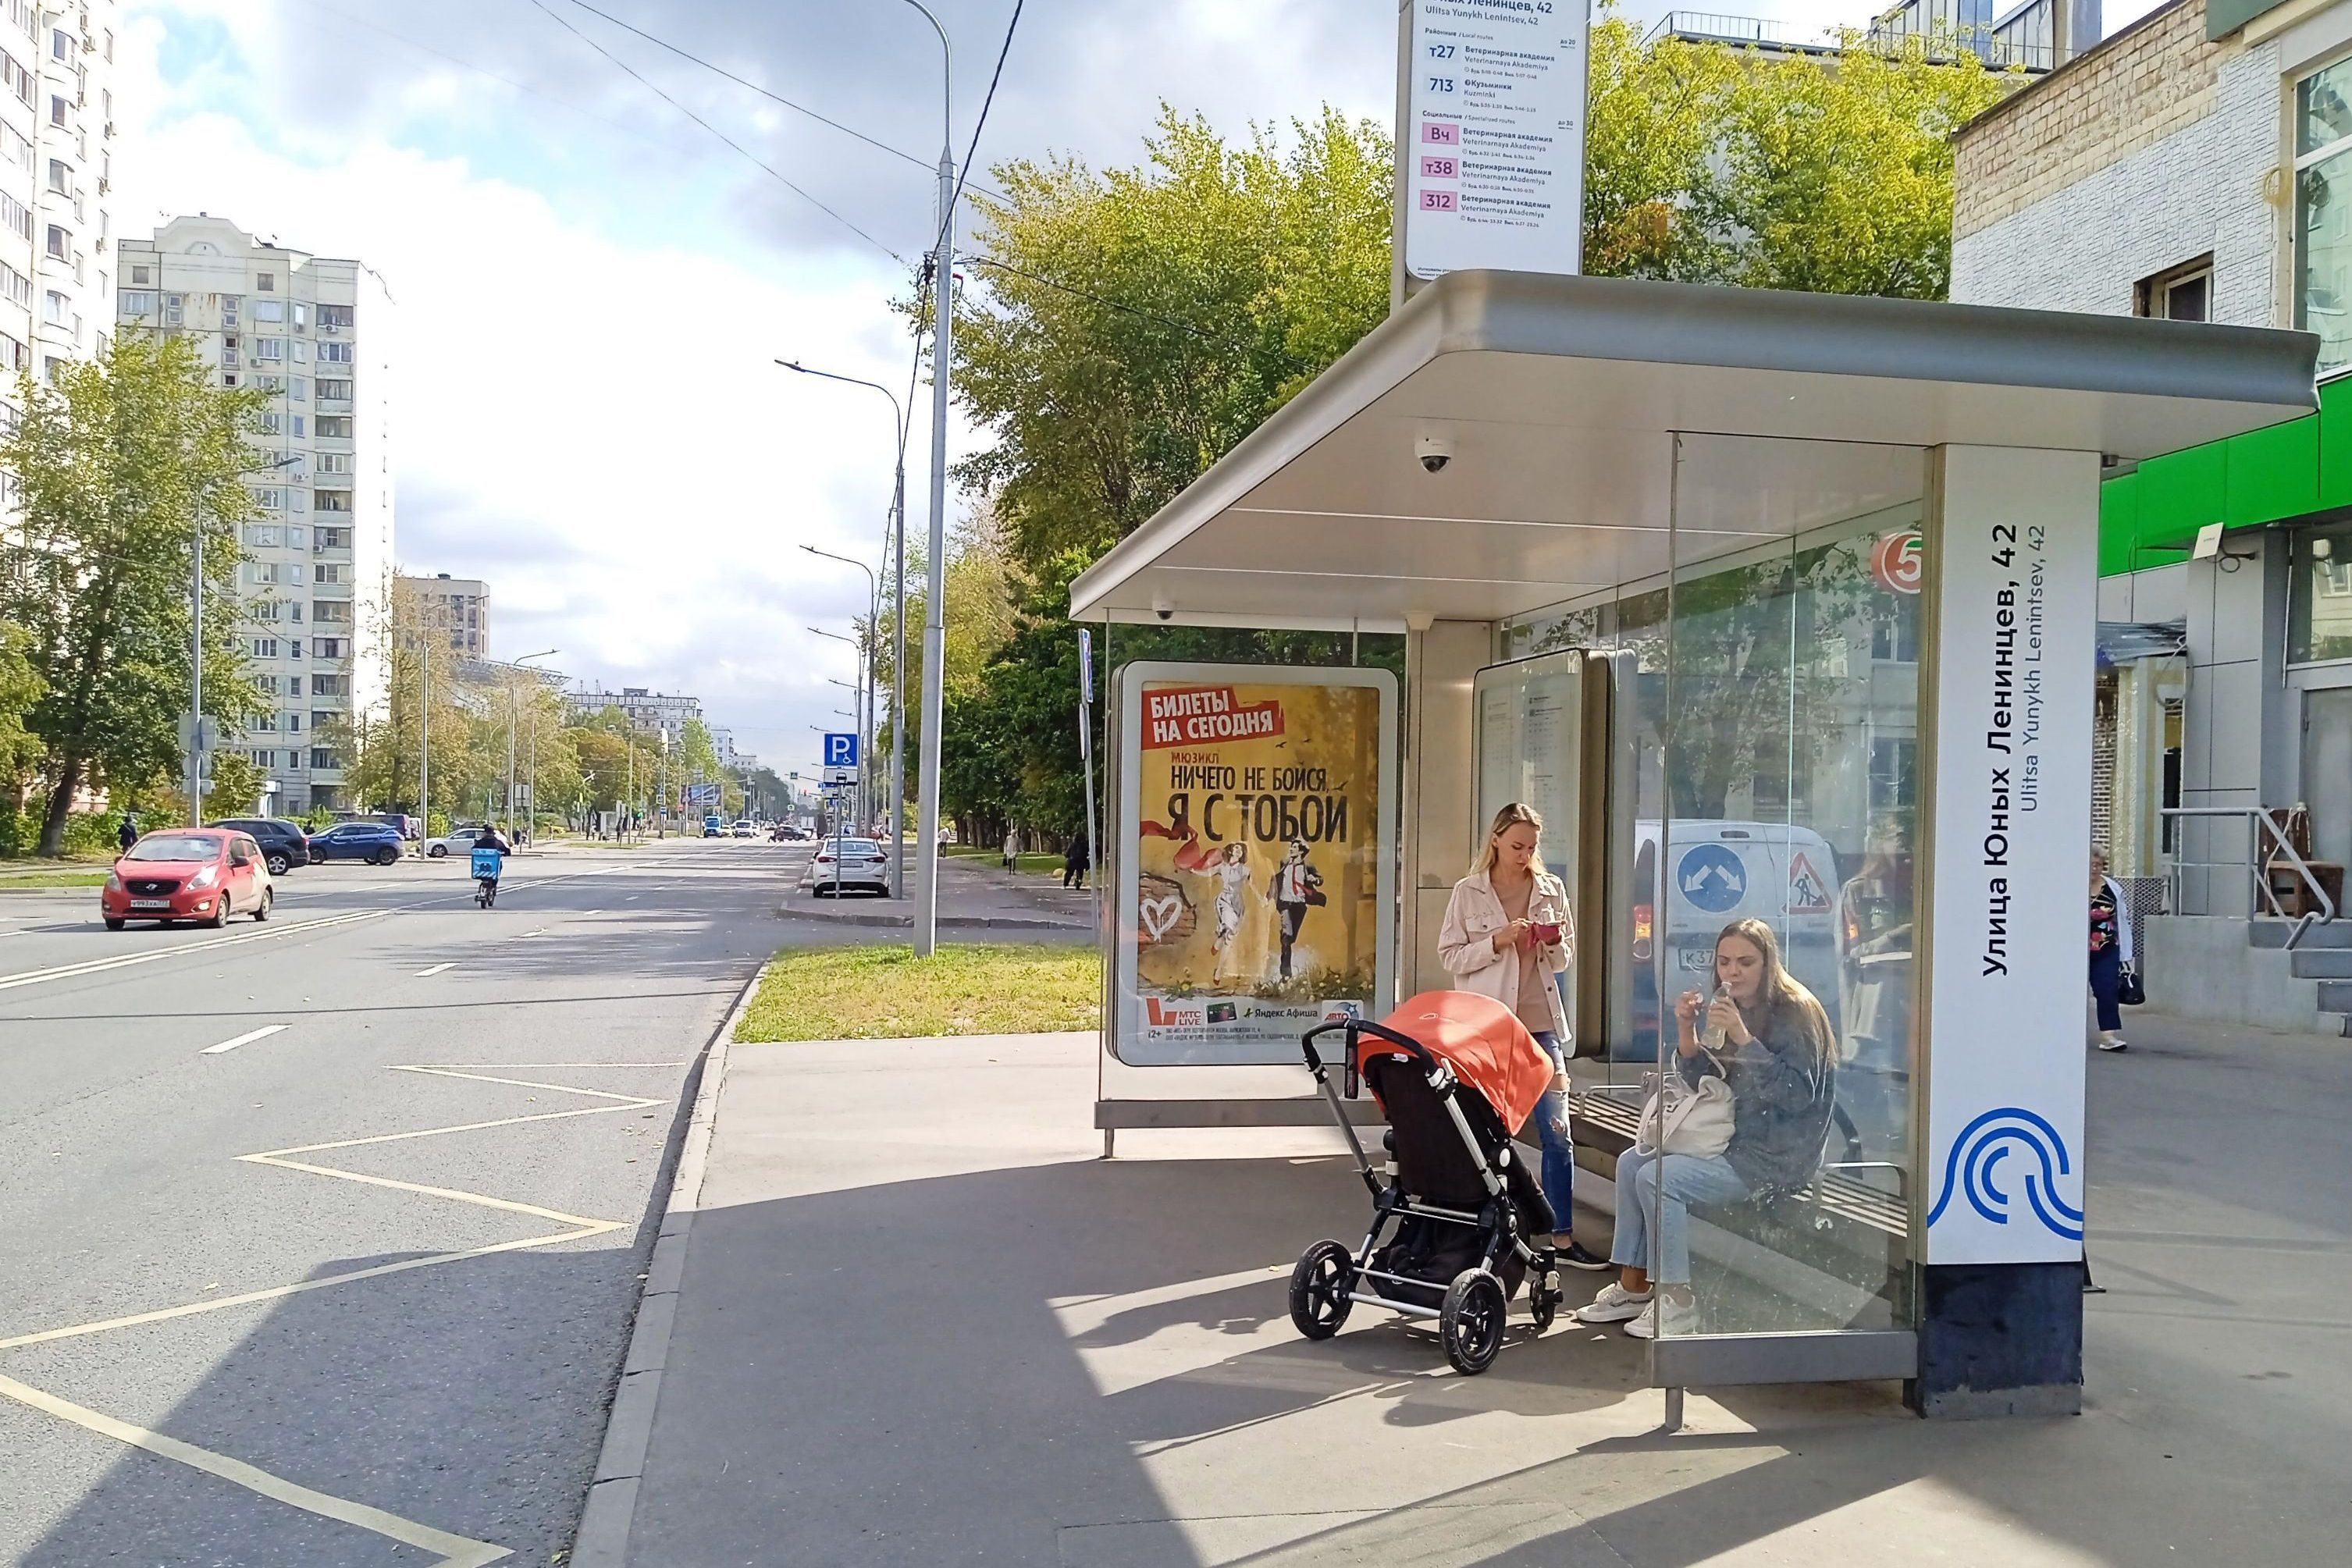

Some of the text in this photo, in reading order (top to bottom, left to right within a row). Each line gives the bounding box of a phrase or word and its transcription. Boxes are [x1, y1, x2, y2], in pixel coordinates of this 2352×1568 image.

[1537, 2, 1553, 13] 42
[1425, 5, 1539, 26] Ulitsa Yunykh Lenintsev, 42
[1465, 46, 1555, 62] Ветеринарная академия
[1464, 55, 1549, 72] Veterinarnaya Akademiya
[1429, 77, 1454, 92] 713
[1471, 80, 1512, 91] Кузьминки
[1464, 89, 1496, 98] Kuzminki
[1463, 127, 1553, 144] Ветеринарная академия
[1463, 137, 1546, 152] Veterinarnaya Akademiya
[1462, 161, 1552, 176] Ветеринарная академия
[1462, 171, 1546, 186] Veterinarnaya Akademiya
[1425, 194, 1450, 208] 312
[1461, 194, 1551, 210] Ветеринарная академия
[1461, 204, 1545, 219] Veterinarnaya Akademiya
[2020, 524, 2047, 812] Ulitsa Yunykh Lenintsev, 42
[1150, 690, 1230, 719] БИЛЕТЫ
[1153, 710, 1273, 743] НА СЕГОДНЯ
[1172, 752, 1219, 764] МЮЗИКЛ
[1983, 524, 2020, 977] Улица Юных Ленинцев, 42
[1171, 765, 1236, 790] НИЧЕГО
[1244, 766, 1266, 791] НЕ
[1168, 792, 1189, 841] Я
[1204, 793, 1224, 841] С
[1254, 1008, 1318, 1019] Яндекс Афиша
[1148, 1029, 1162, 1038] 12+
